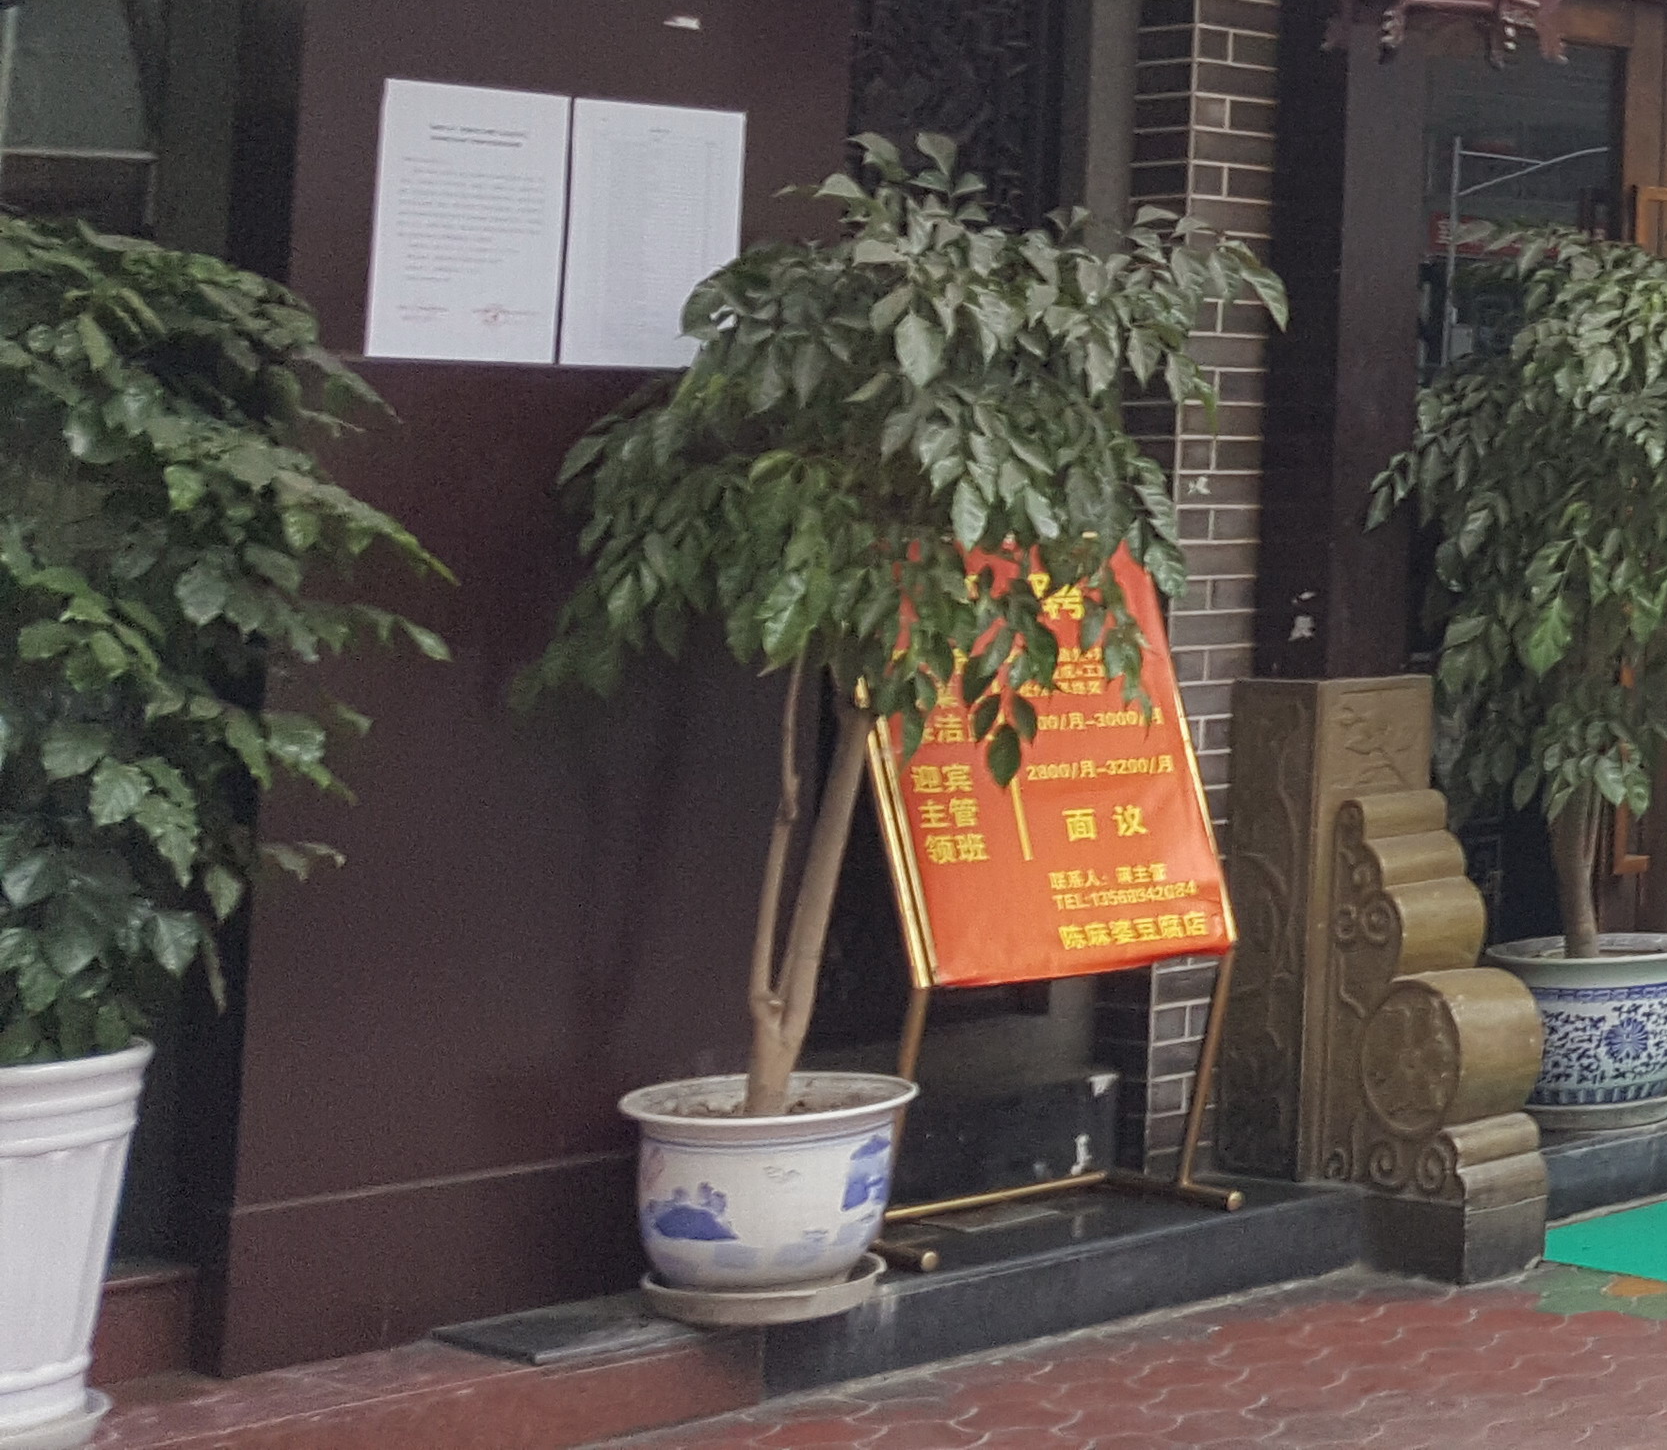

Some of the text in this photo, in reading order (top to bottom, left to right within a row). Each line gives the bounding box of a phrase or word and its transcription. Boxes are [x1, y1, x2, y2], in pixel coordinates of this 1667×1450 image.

[911, 763, 973, 793] 迎宾
[917, 798, 979, 829] 主管
[1061, 804, 1148, 842] 面议
[925, 833, 991, 865] 领班
